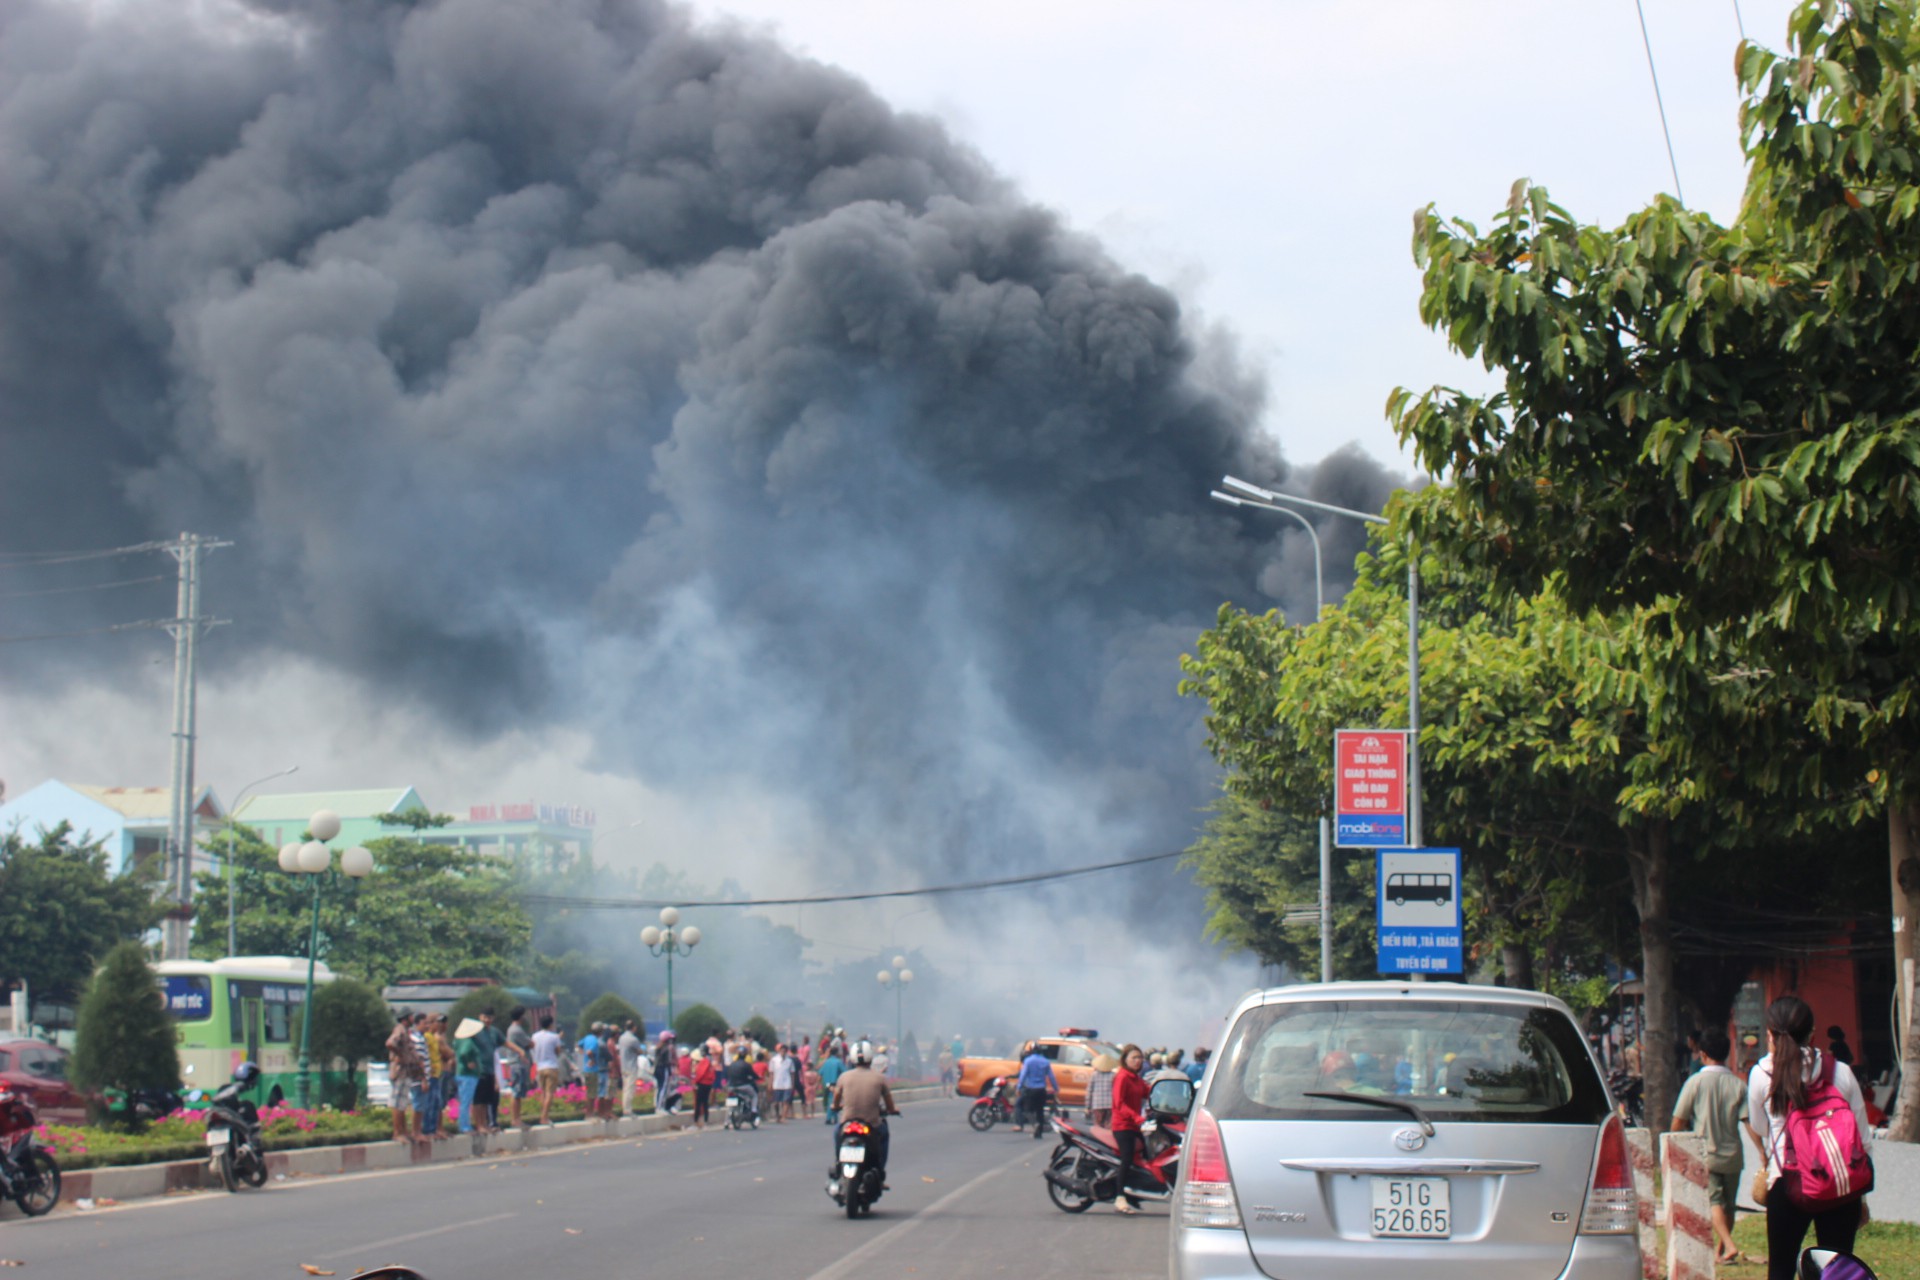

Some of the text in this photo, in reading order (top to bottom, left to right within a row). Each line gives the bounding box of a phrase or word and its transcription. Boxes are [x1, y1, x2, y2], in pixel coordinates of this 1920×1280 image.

[1353, 754, 1389, 766] TAI NẠN
[1344, 767, 1397, 779] GIAO THÔNG
[1370, 783, 1389, 794] ĐAU
[1339, 822, 1402, 834] mobifone
[1436, 933, 1459, 948] KHÁCH
[1390, 1182, 1430, 1206] 51G
[1374, 1208, 1446, 1232] 526.65
